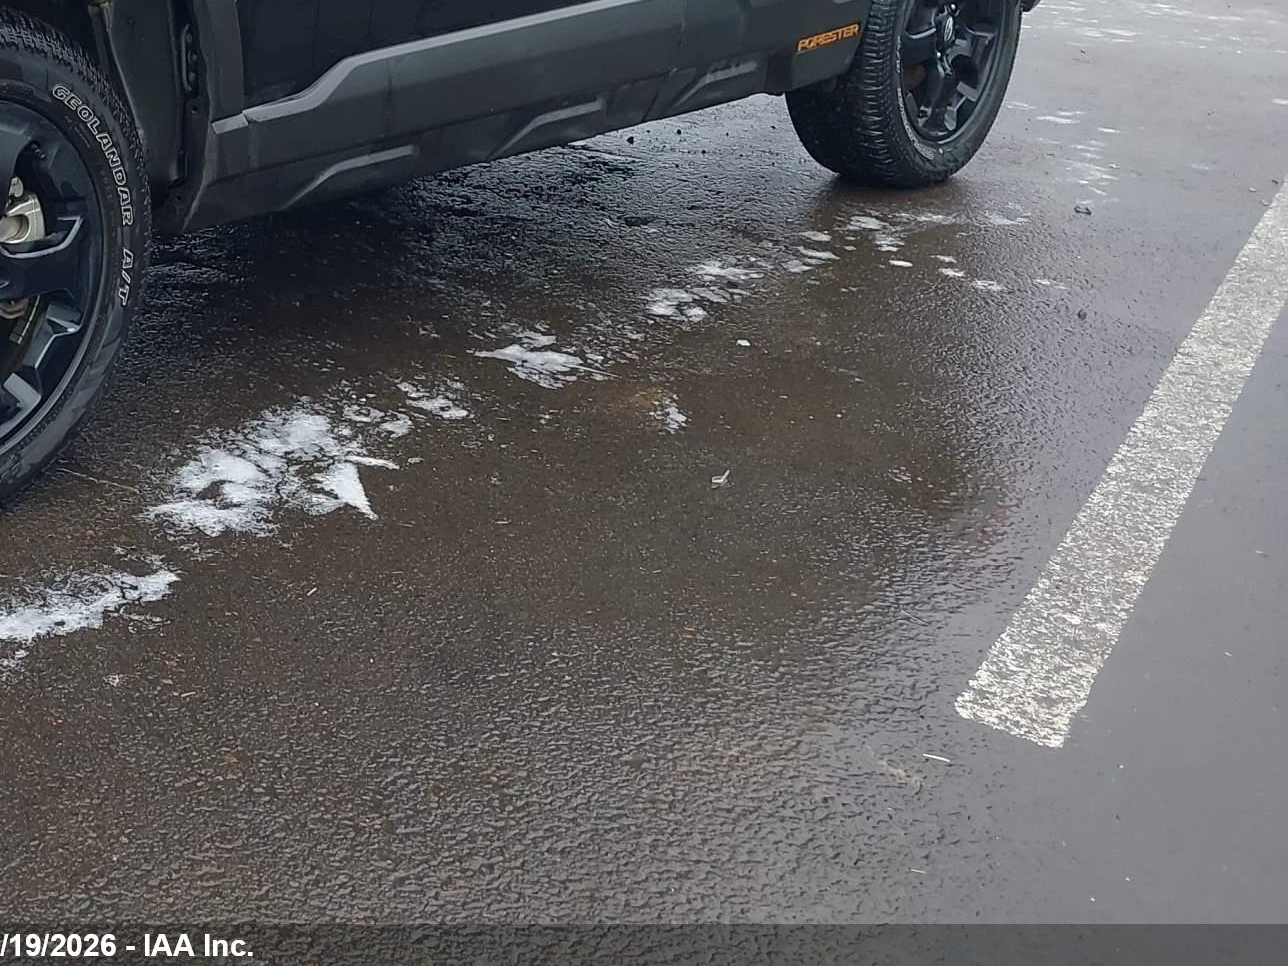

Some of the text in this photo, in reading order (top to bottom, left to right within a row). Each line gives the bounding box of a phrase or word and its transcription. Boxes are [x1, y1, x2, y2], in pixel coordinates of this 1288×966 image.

[797, 23, 859, 52] FORESTER
[51, 83, 135, 307] GEOLANDAR A/T
